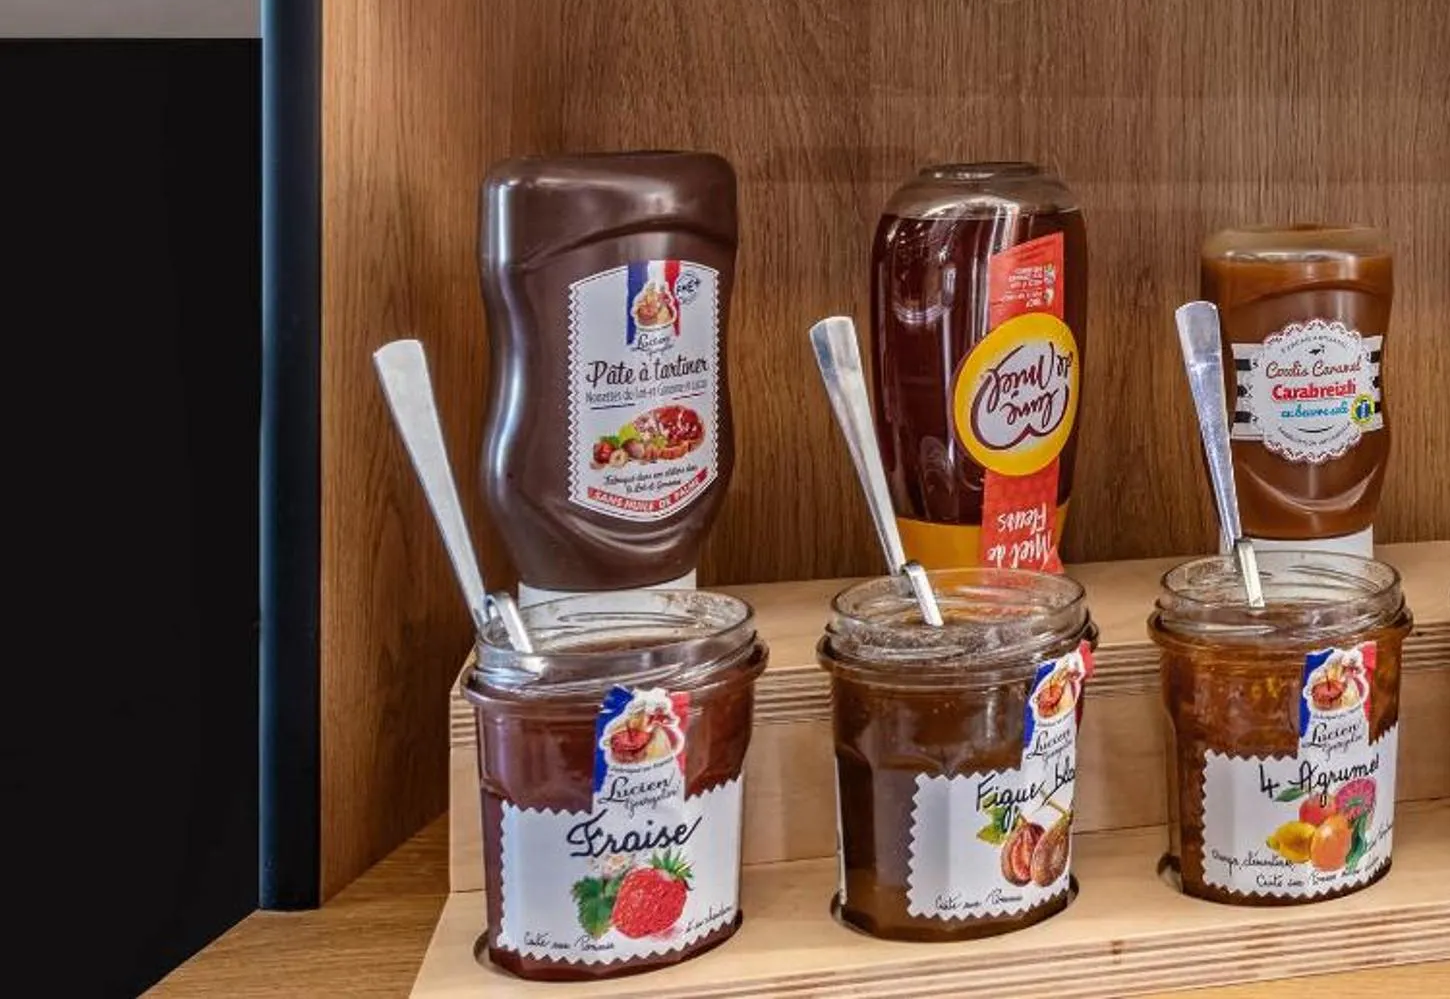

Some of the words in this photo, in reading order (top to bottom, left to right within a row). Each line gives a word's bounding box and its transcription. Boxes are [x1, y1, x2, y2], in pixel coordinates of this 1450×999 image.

[586, 360, 635, 389] Pâte
[639, 362, 651, 382] à
[654, 355, 708, 381] tartiner
[997, 502, 1048, 534] Fleurs
[986, 547, 1007, 565] de
[1302, 719, 1361, 749] Lucien
[598, 770, 675, 804] Lucien
[1258, 763, 1280, 799] 4
[567, 808, 703, 859] Fraise
